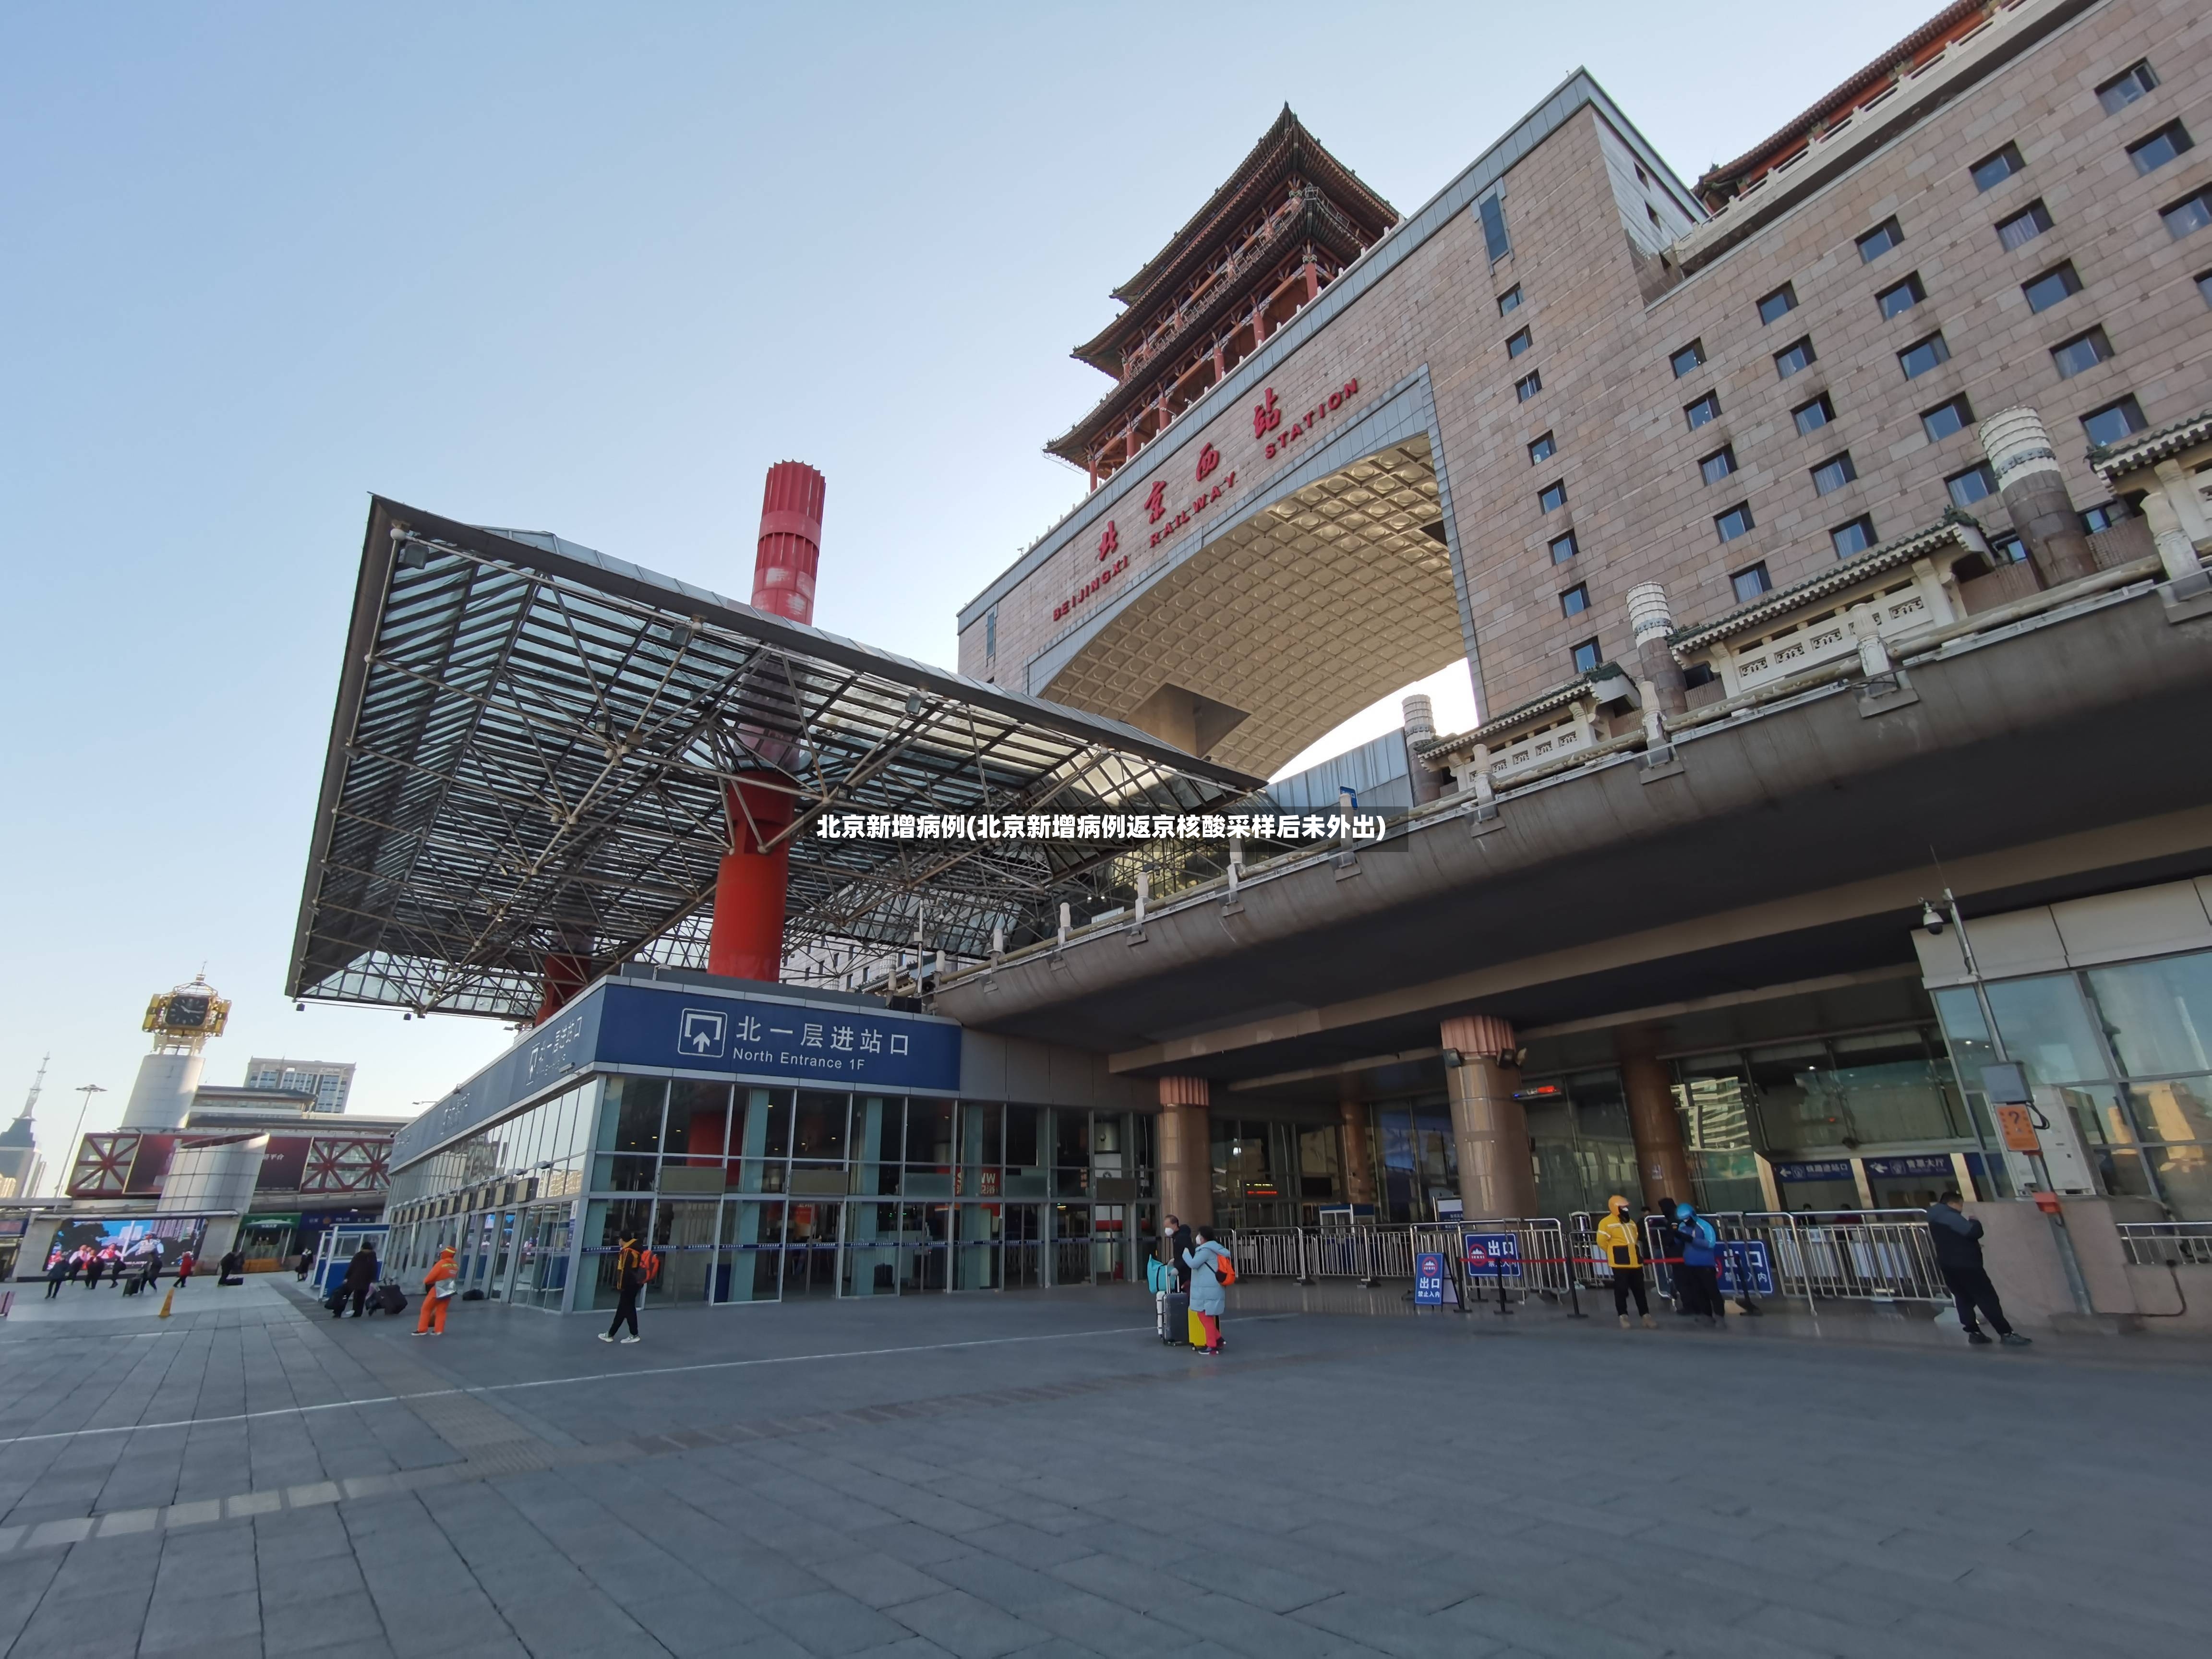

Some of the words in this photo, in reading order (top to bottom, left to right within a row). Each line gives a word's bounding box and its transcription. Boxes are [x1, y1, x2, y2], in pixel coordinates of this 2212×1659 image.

[1053, 555, 1129, 622] BEIJINGXI
[1149, 471, 1237, 548] RAILWAY
[1265, 378, 1358, 459] STATION
[736, 1015, 909, 1056] 北一层进站口
[733, 1047, 773, 1063] North
[780, 1052, 842, 1069] Entrance
[849, 1058, 865, 1070] 1F
[1488, 1239, 1514, 1256] 出口
[1419, 1276, 1440, 1289] 出口
